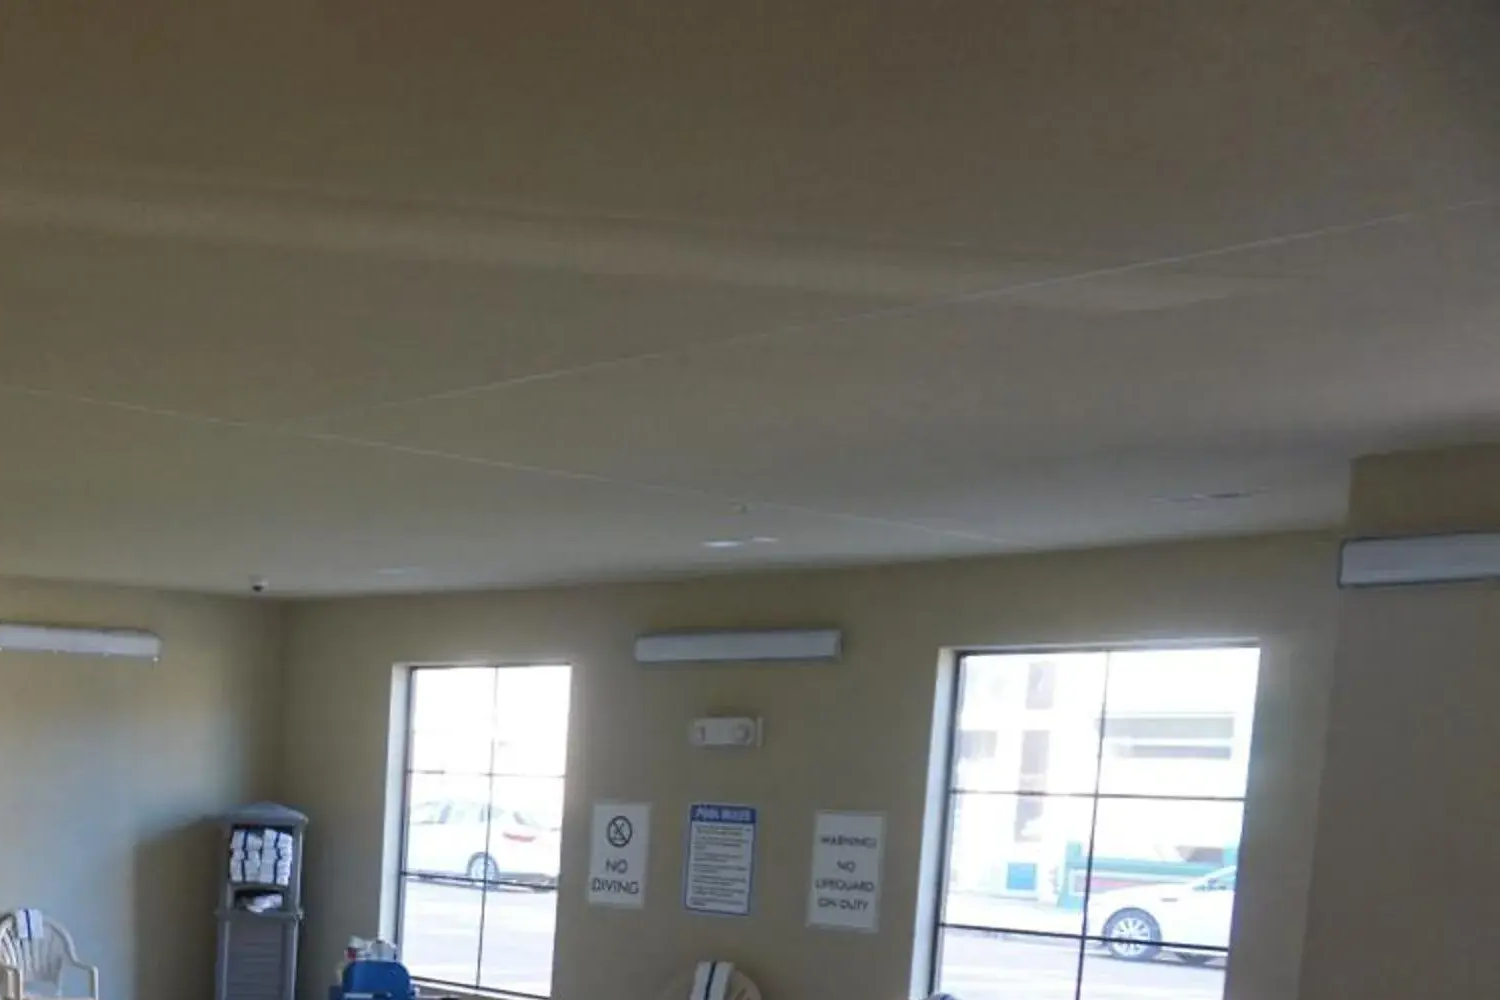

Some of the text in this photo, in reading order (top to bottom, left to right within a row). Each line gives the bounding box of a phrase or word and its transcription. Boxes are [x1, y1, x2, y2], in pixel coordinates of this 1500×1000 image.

[605, 858, 628, 874] NO
[836, 859, 856, 874] NO
[591, 877, 639, 895] DIVING
[815, 877, 875, 892] LIFEGUARD
[839, 898, 869, 912] DUTY
